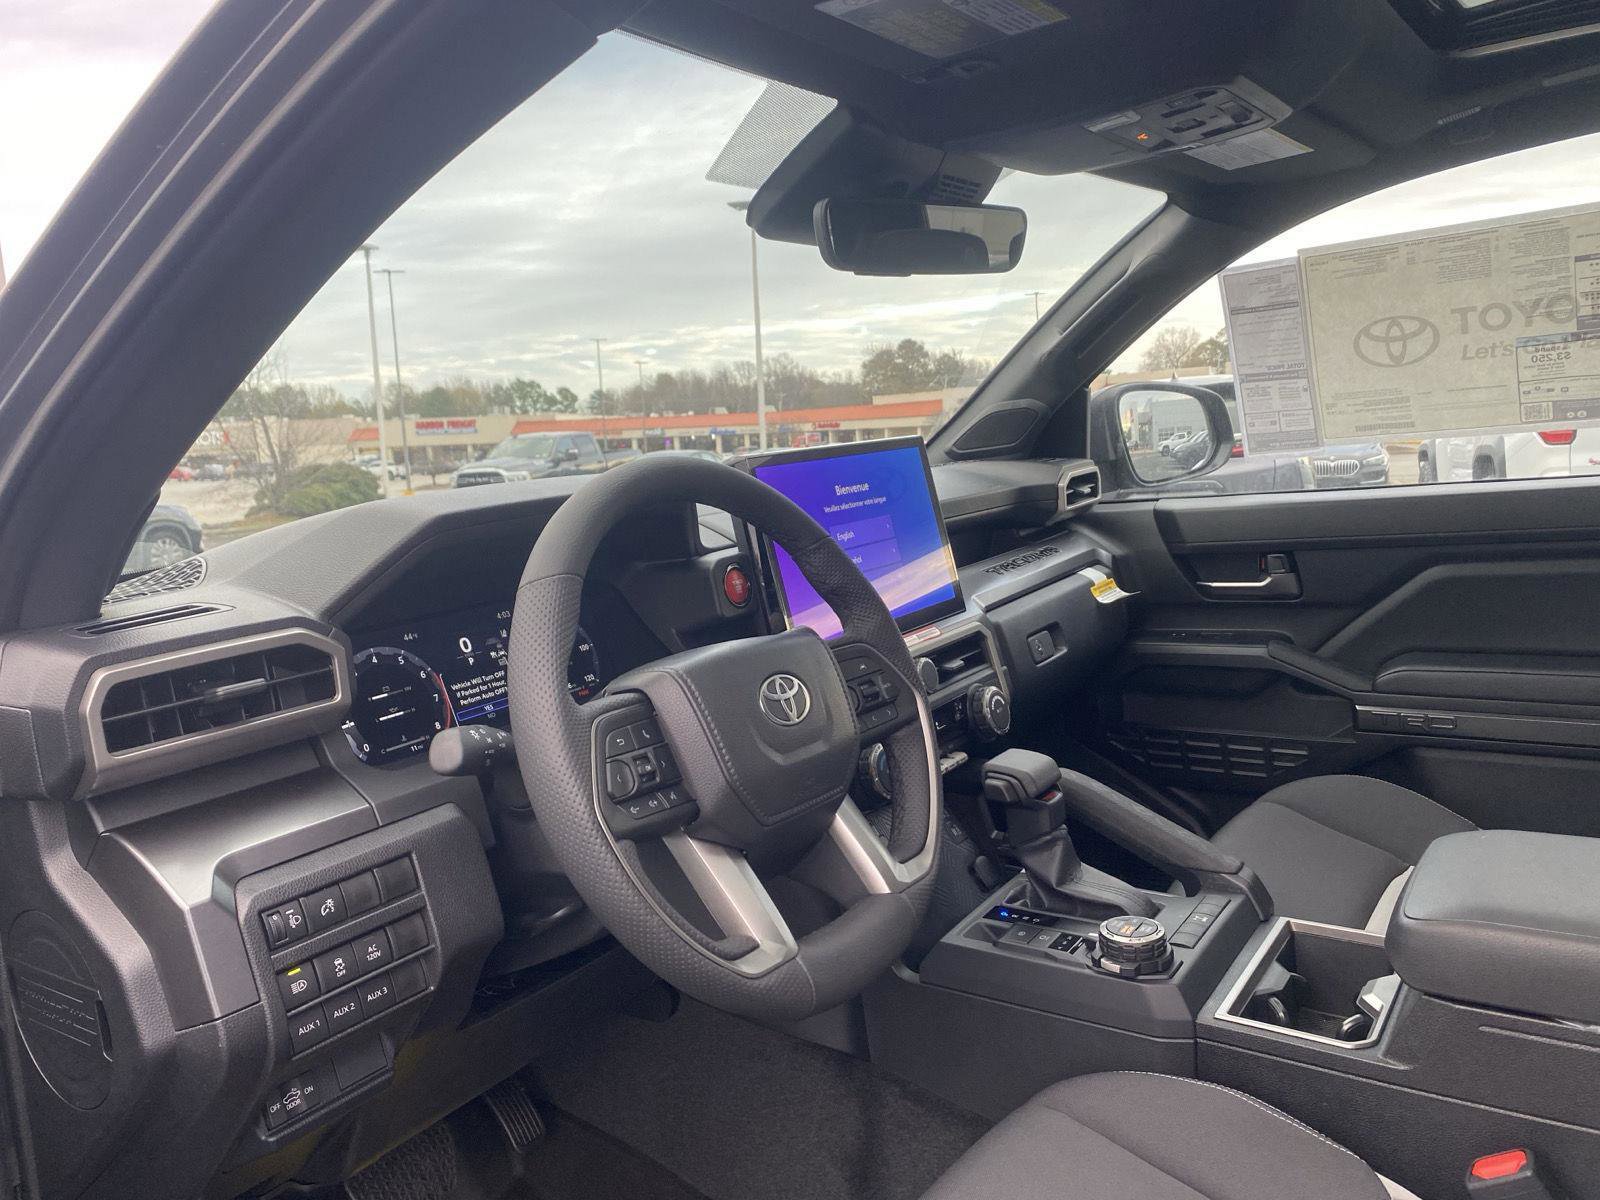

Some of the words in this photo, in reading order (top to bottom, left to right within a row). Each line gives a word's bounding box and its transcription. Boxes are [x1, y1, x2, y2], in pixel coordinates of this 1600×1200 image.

[1450, 296, 1575, 335] TOYO
[1461, 340, 1514, 360] Let's
[834, 482, 869, 496] Bienvenue
[836, 531, 855, 542] English
[983, 545, 1061, 575] TACOMA
[459, 637, 472, 653] 0
[578, 643, 590, 652] 100
[371, 655, 378, 664] 4
[397, 655, 405, 665] 5
[468, 656, 475, 666] P
[420, 670, 427, 679] 6
[584, 673, 595, 682] 120
[450, 681, 471, 691] Vehicle
[471, 676, 483, 685] Will
[482, 674, 495, 682] Turn
[494, 670, 505, 678] OFF
[461, 686, 480, 697] Parked
[480, 684, 488, 692] for
[432, 693, 439, 702] 7
[460, 696, 482, 706] Perform
[482, 691, 495, 699] Auto
[434, 721, 441, 730] 8
[363, 743, 370, 752] 0
[368, 943, 378, 953] AC
[366, 949, 381, 961] 120V
[336, 969, 346, 978] OFF
[367, 989, 383, 1002] AUX
[382, 986, 389, 995] 3
[333, 1006, 350, 1019] AUX
[349, 1002, 356, 1010] 2
[298, 1022, 315, 1036] AUX
[315, 1019, 321, 1027] 1
[304, 1084, 314, 1095] ON
[270, 1102, 281, 1113] OFF
[286, 1098, 302, 1111] DOOR
